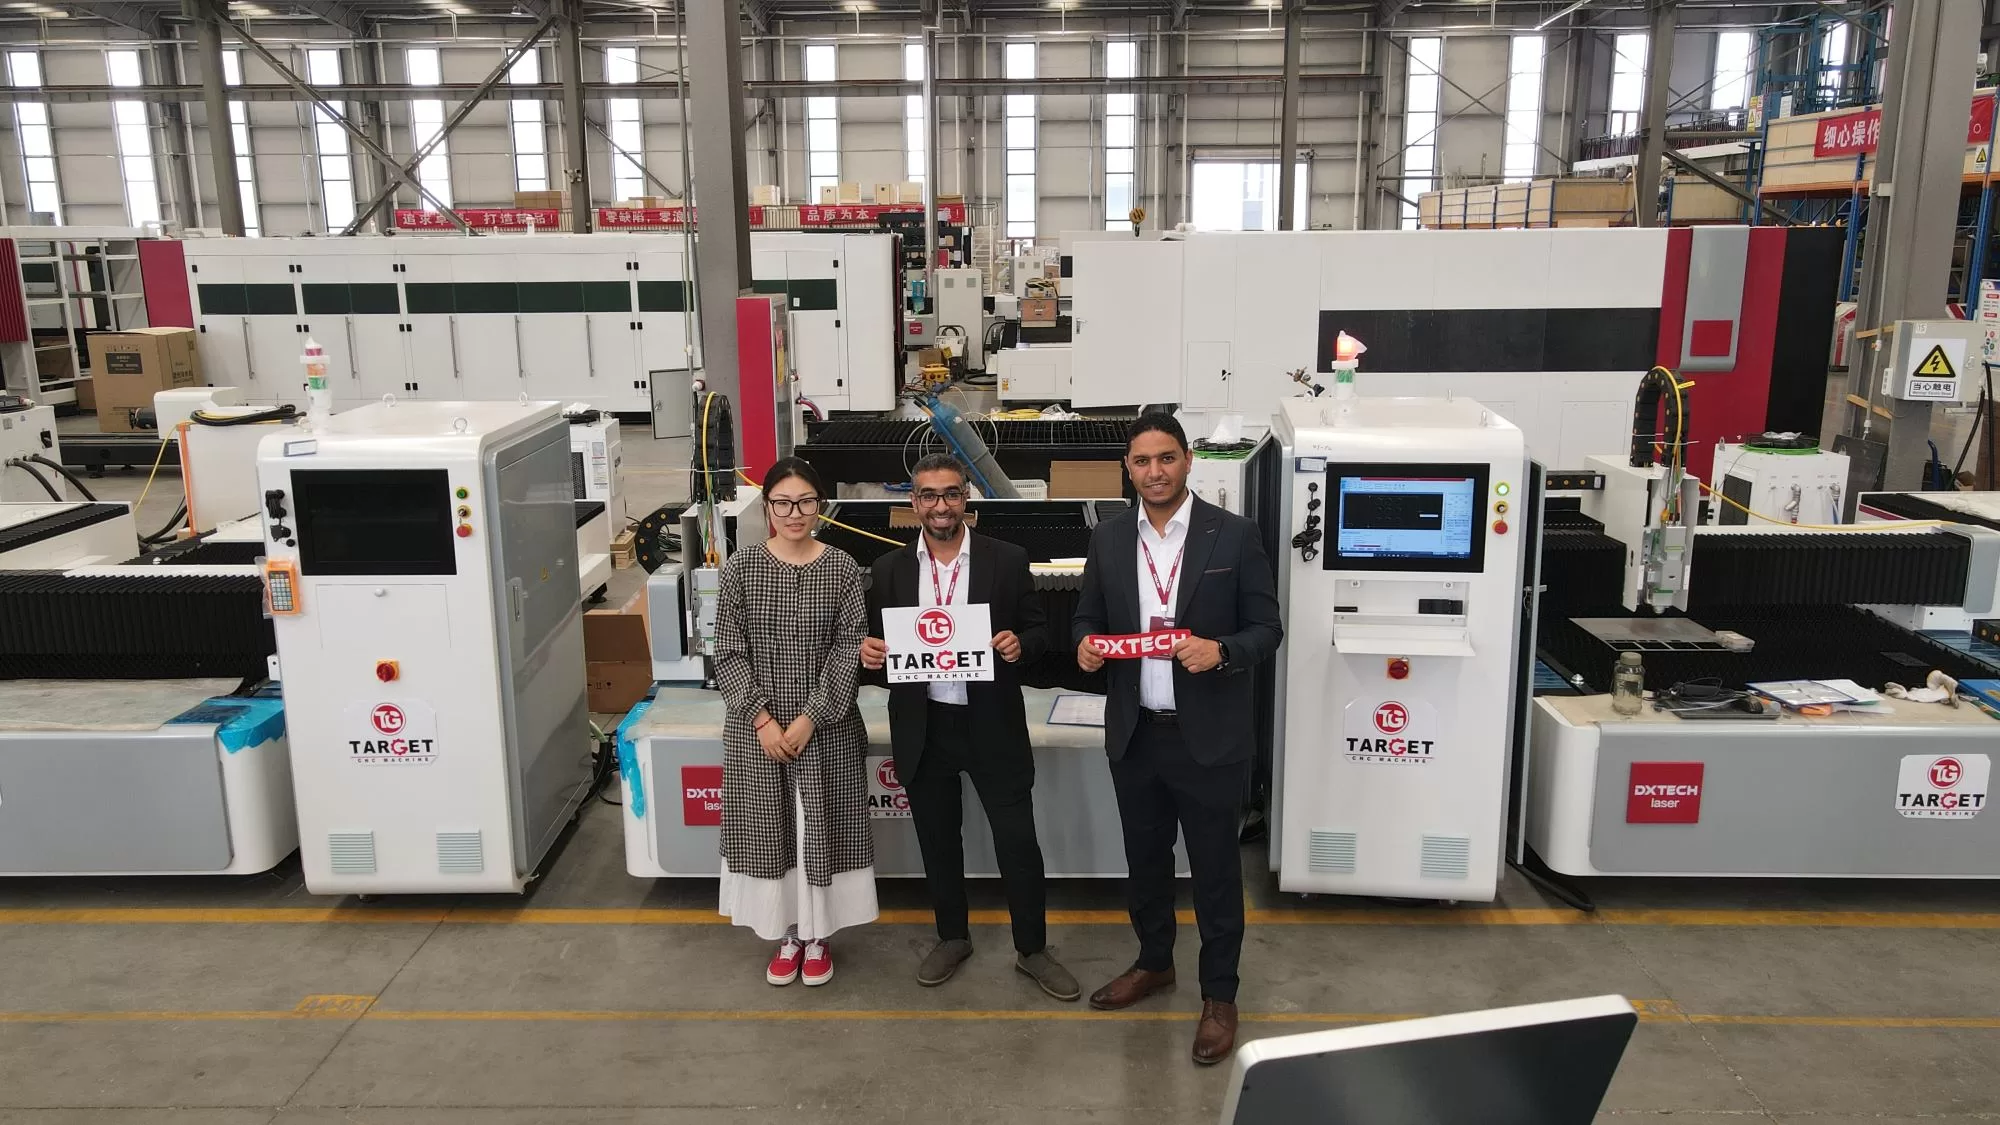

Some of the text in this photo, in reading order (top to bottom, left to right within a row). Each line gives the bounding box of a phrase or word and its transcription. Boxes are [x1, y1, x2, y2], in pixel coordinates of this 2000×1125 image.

[1913, 383, 1951, 391] 当心触电
[919, 617, 950, 639] TG
[889, 650, 985, 671] TARGET
[927, 672, 979, 680] MACHINE
[374, 710, 402, 729] TG
[1377, 709, 1405, 728] TG
[348, 738, 434, 755] TARGET
[1346, 738, 1434, 755] TARGET
[1933, 764, 1959, 782] TG
[1634, 784, 1698, 796] DXTECH
[1651, 797, 1680, 808] laser
[1899, 792, 1985, 809] TARGET
